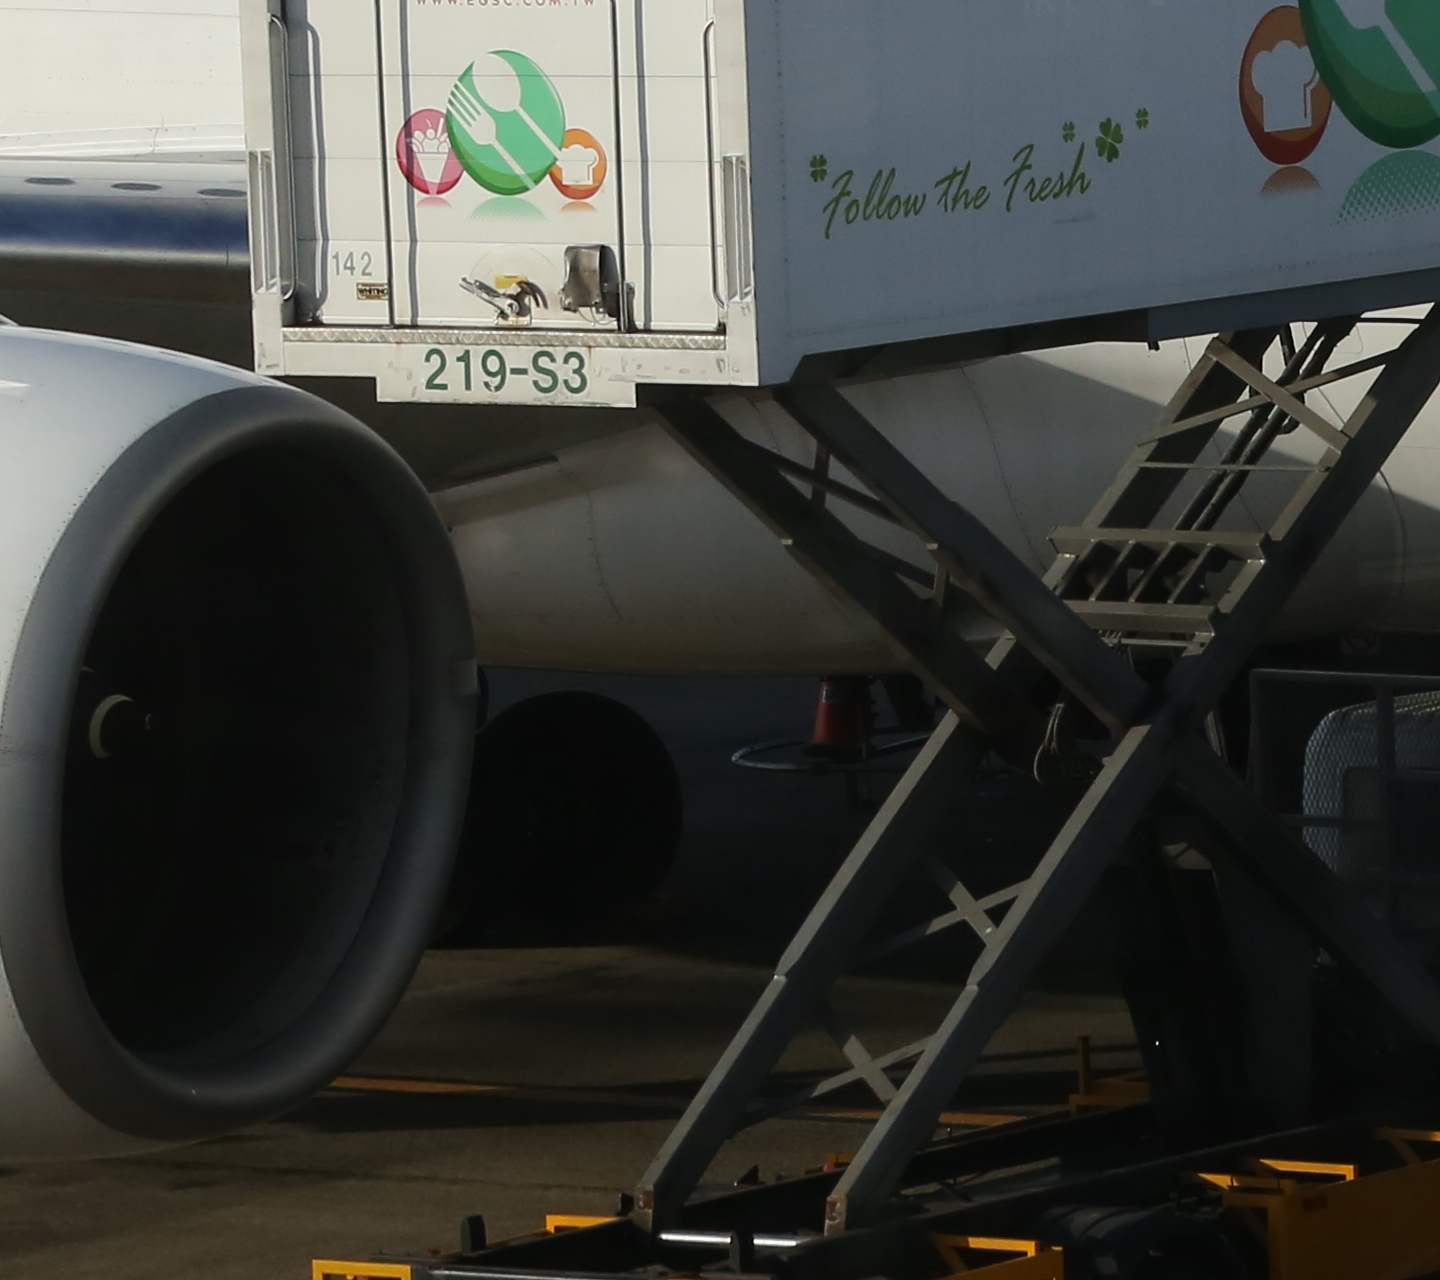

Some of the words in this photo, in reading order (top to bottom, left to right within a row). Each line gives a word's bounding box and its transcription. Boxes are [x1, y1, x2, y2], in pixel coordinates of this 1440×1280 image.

[822, 168, 927, 240] Follow
[1003, 141, 1092, 213] Fresh
[332, 251, 373, 277] 142
[424, 348, 588, 395] 219-S3
